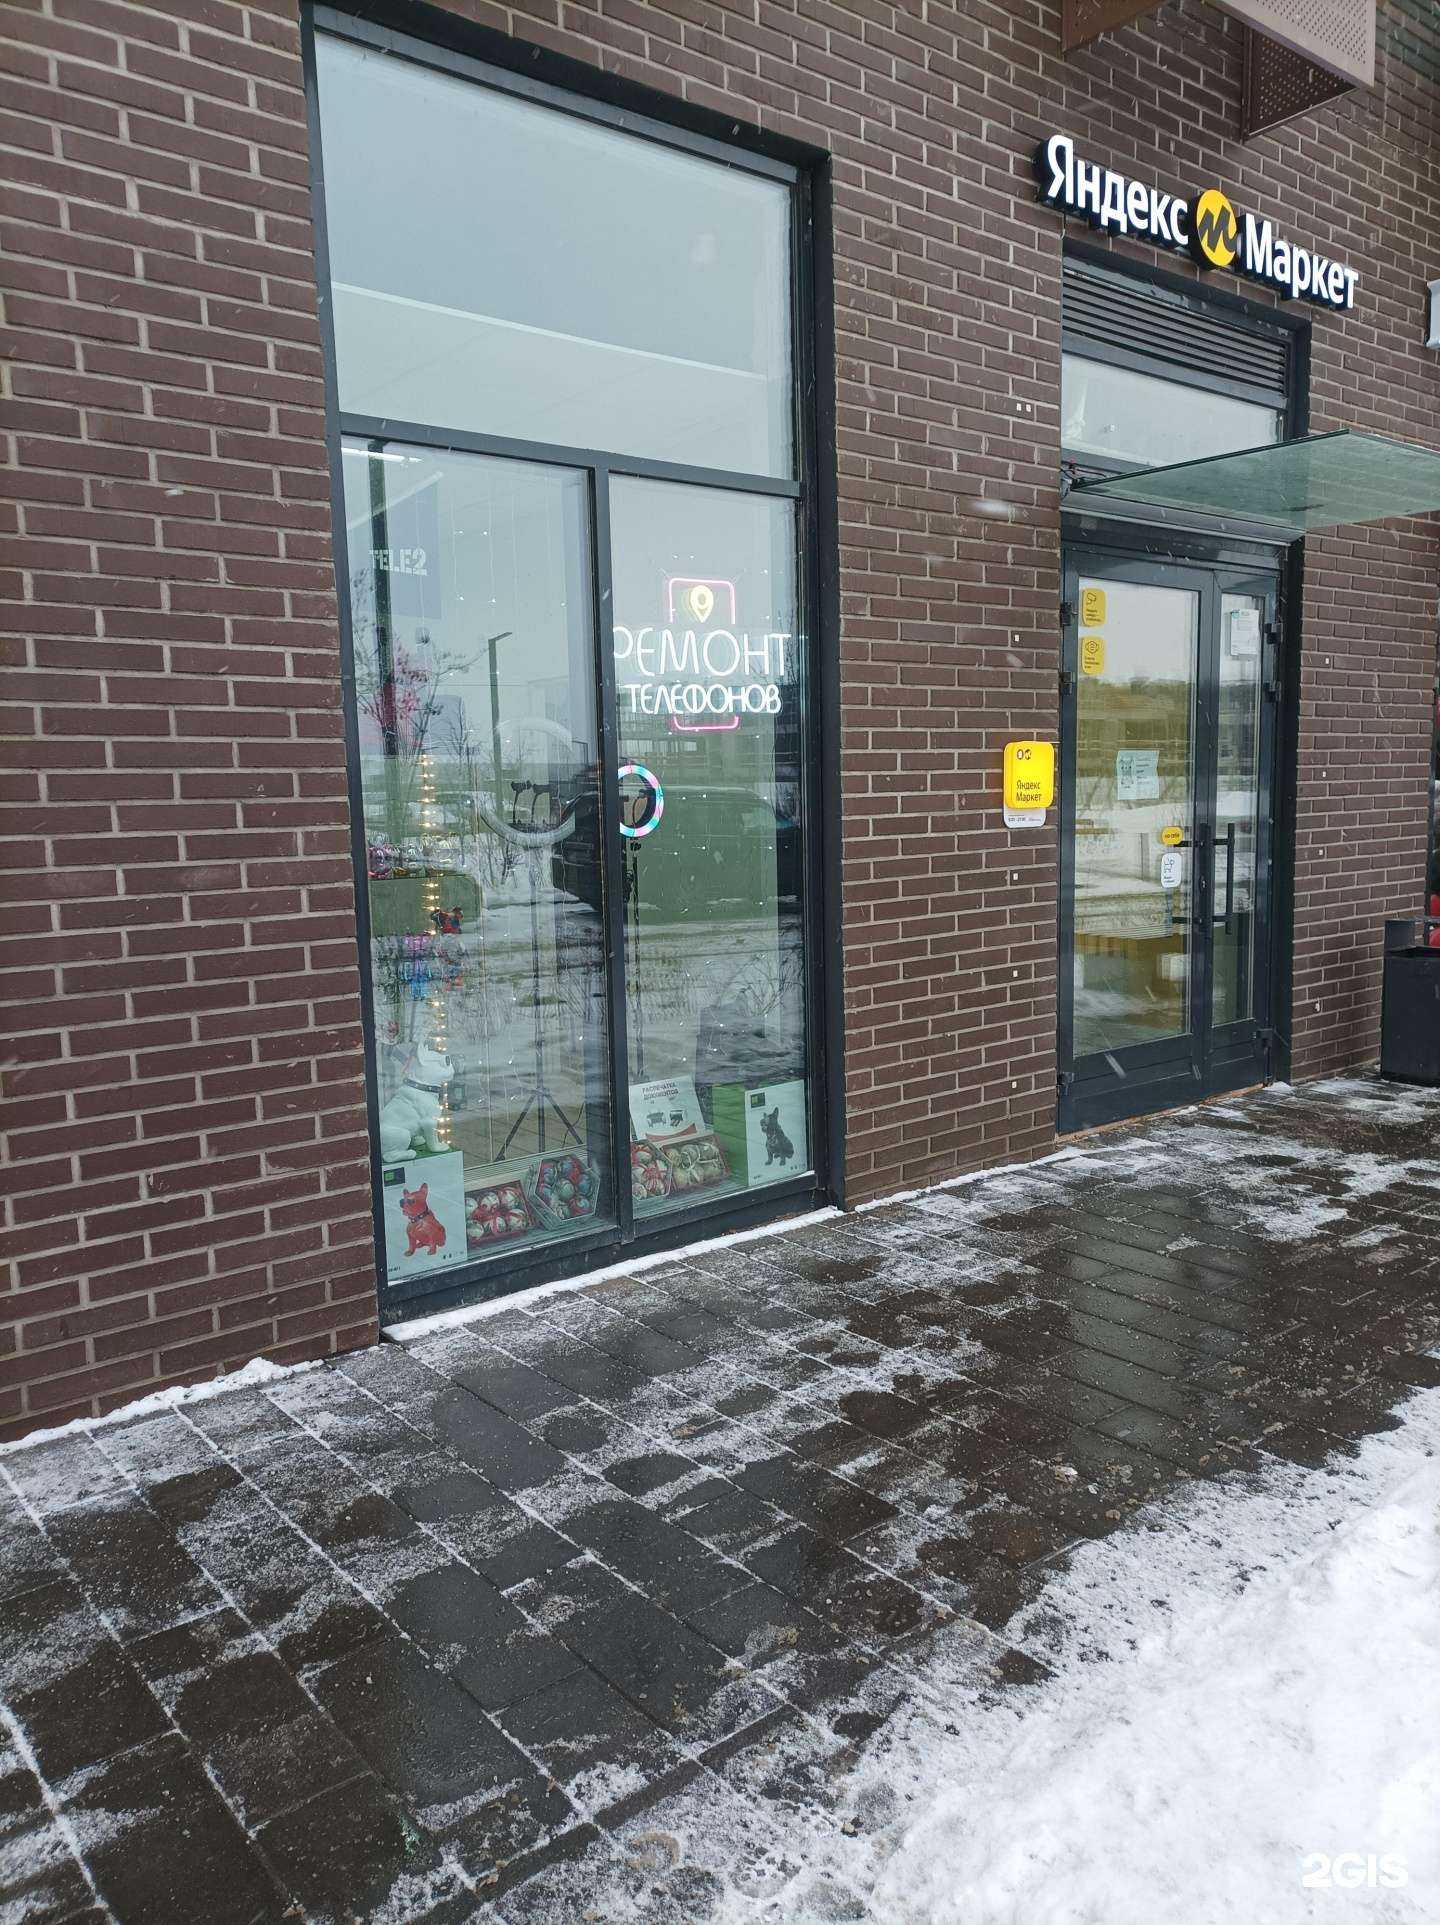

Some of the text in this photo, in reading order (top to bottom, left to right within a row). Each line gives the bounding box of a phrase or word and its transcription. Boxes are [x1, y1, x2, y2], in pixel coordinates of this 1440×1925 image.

[1046, 133, 1189, 246] Яндекс
[1245, 213, 1359, 309] Маркет
[612, 625, 792, 677] РЕМОНТ
[623, 683, 783, 715] ТЕЛЕФОНОВ
[1015, 792, 1042, 803] Маркет
[1016, 780, 1041, 791] Яндекс
